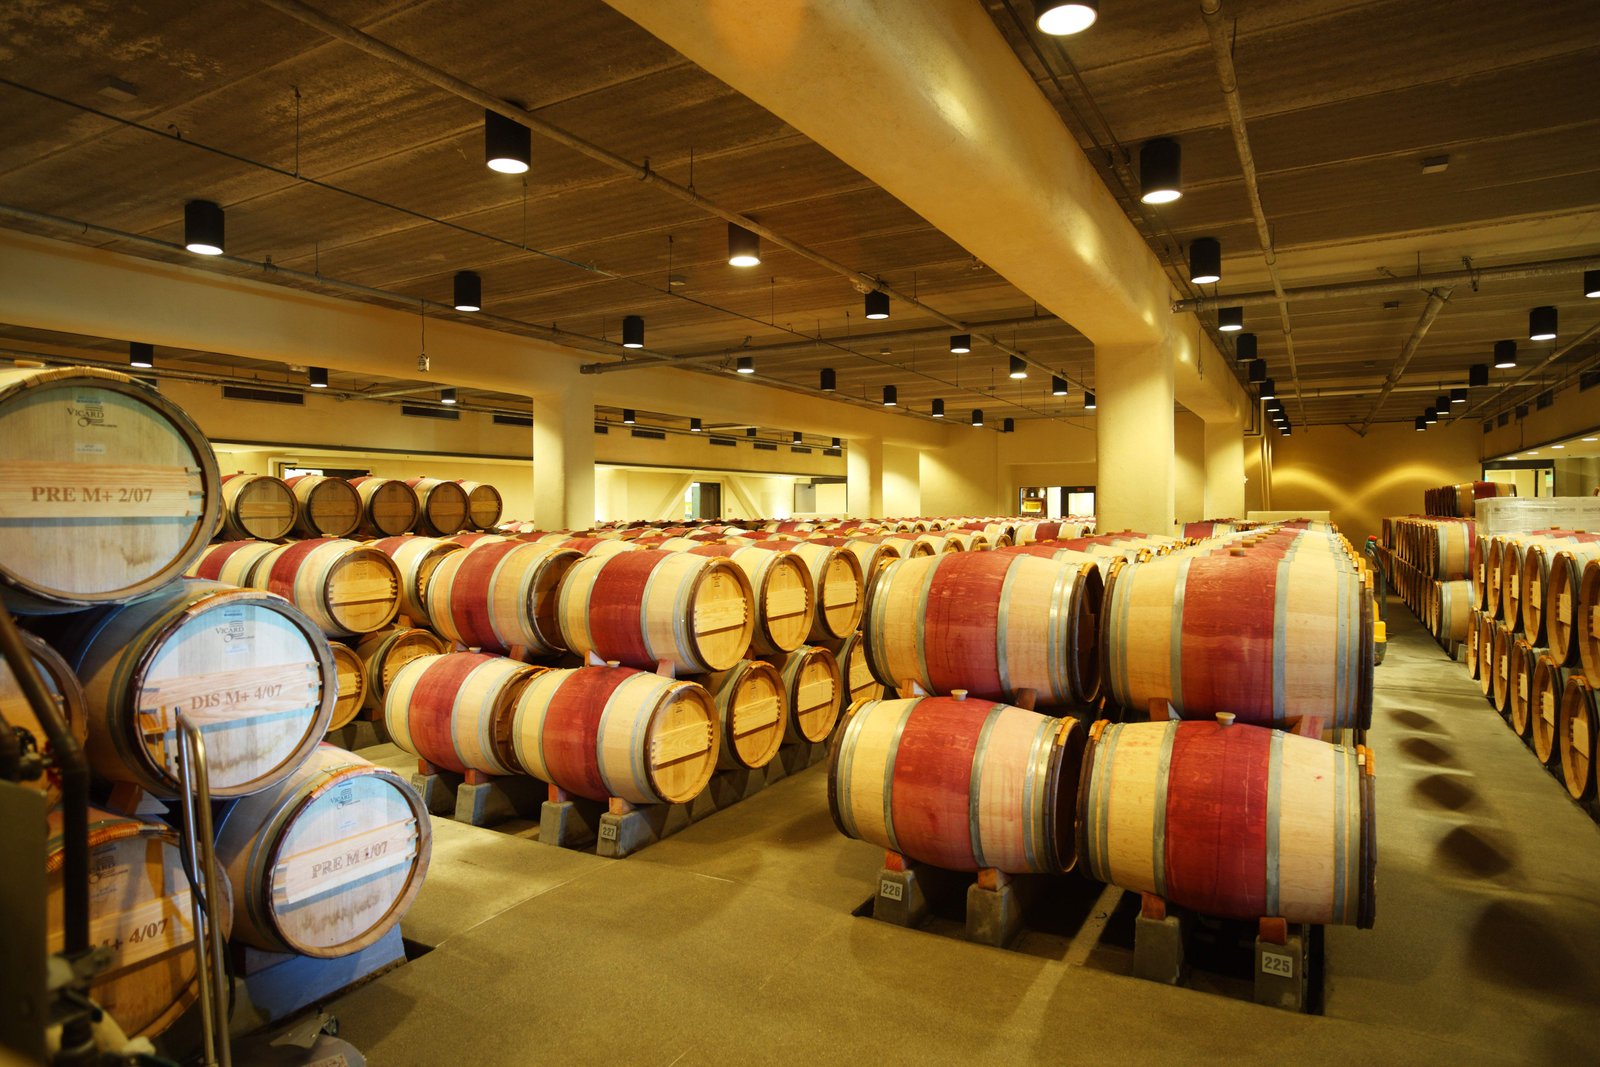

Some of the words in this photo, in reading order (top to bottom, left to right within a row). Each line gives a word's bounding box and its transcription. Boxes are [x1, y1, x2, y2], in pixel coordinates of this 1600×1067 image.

[66, 407, 104, 418] VICARD
[31, 486, 76, 502] PRE
[82, 487, 113, 503] M+
[118, 488, 153, 503] 2/07
[191, 693, 220, 710] DIS
[225, 690, 250, 705] M+
[254, 684, 282, 700] 4/07
[602, 826, 615, 837] 227
[311, 856, 343, 879] PRE
[346, 849, 361, 867] M
[882, 884, 900, 897] 226
[128, 917, 169, 944] 4/07
[1264, 956, 1290, 973] 225
